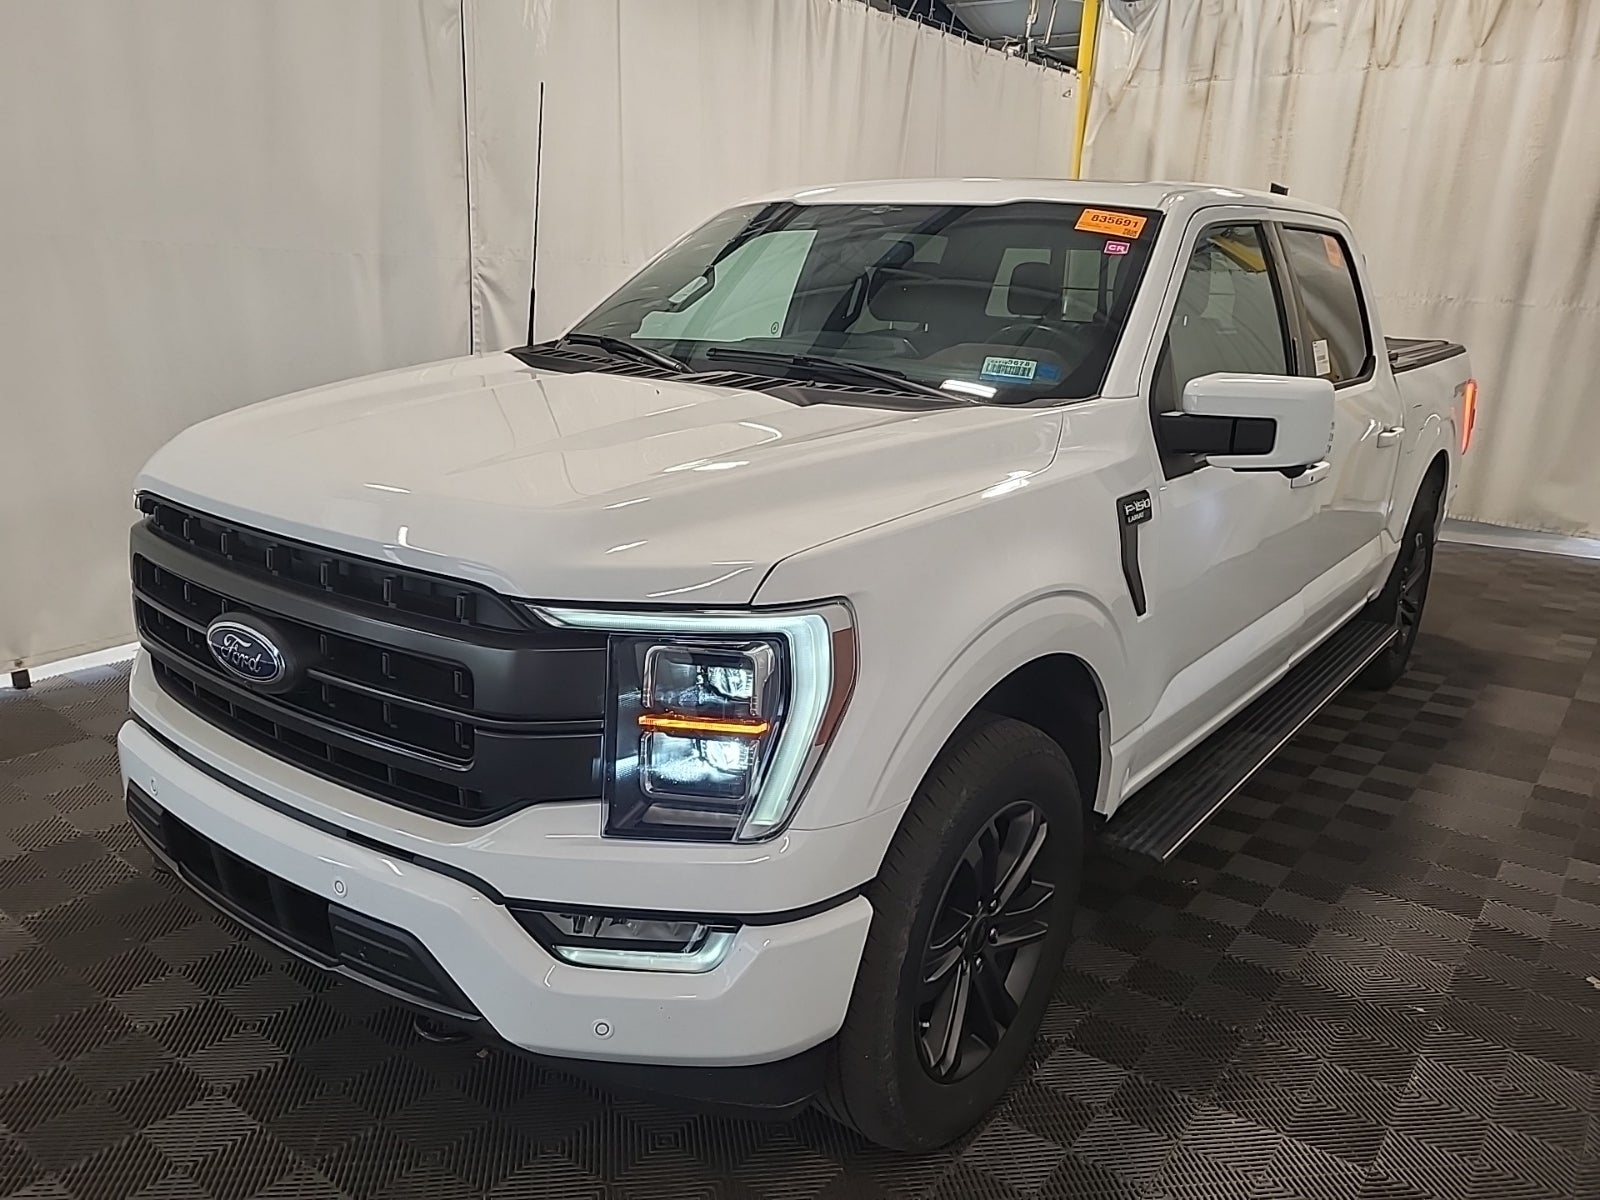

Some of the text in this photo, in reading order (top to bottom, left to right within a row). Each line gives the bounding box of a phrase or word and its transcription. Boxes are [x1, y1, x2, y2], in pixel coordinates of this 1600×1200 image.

[1091, 214, 1139, 228] 835691
[1108, 244, 1126, 253] CR
[221, 633, 262, 673] Ford
